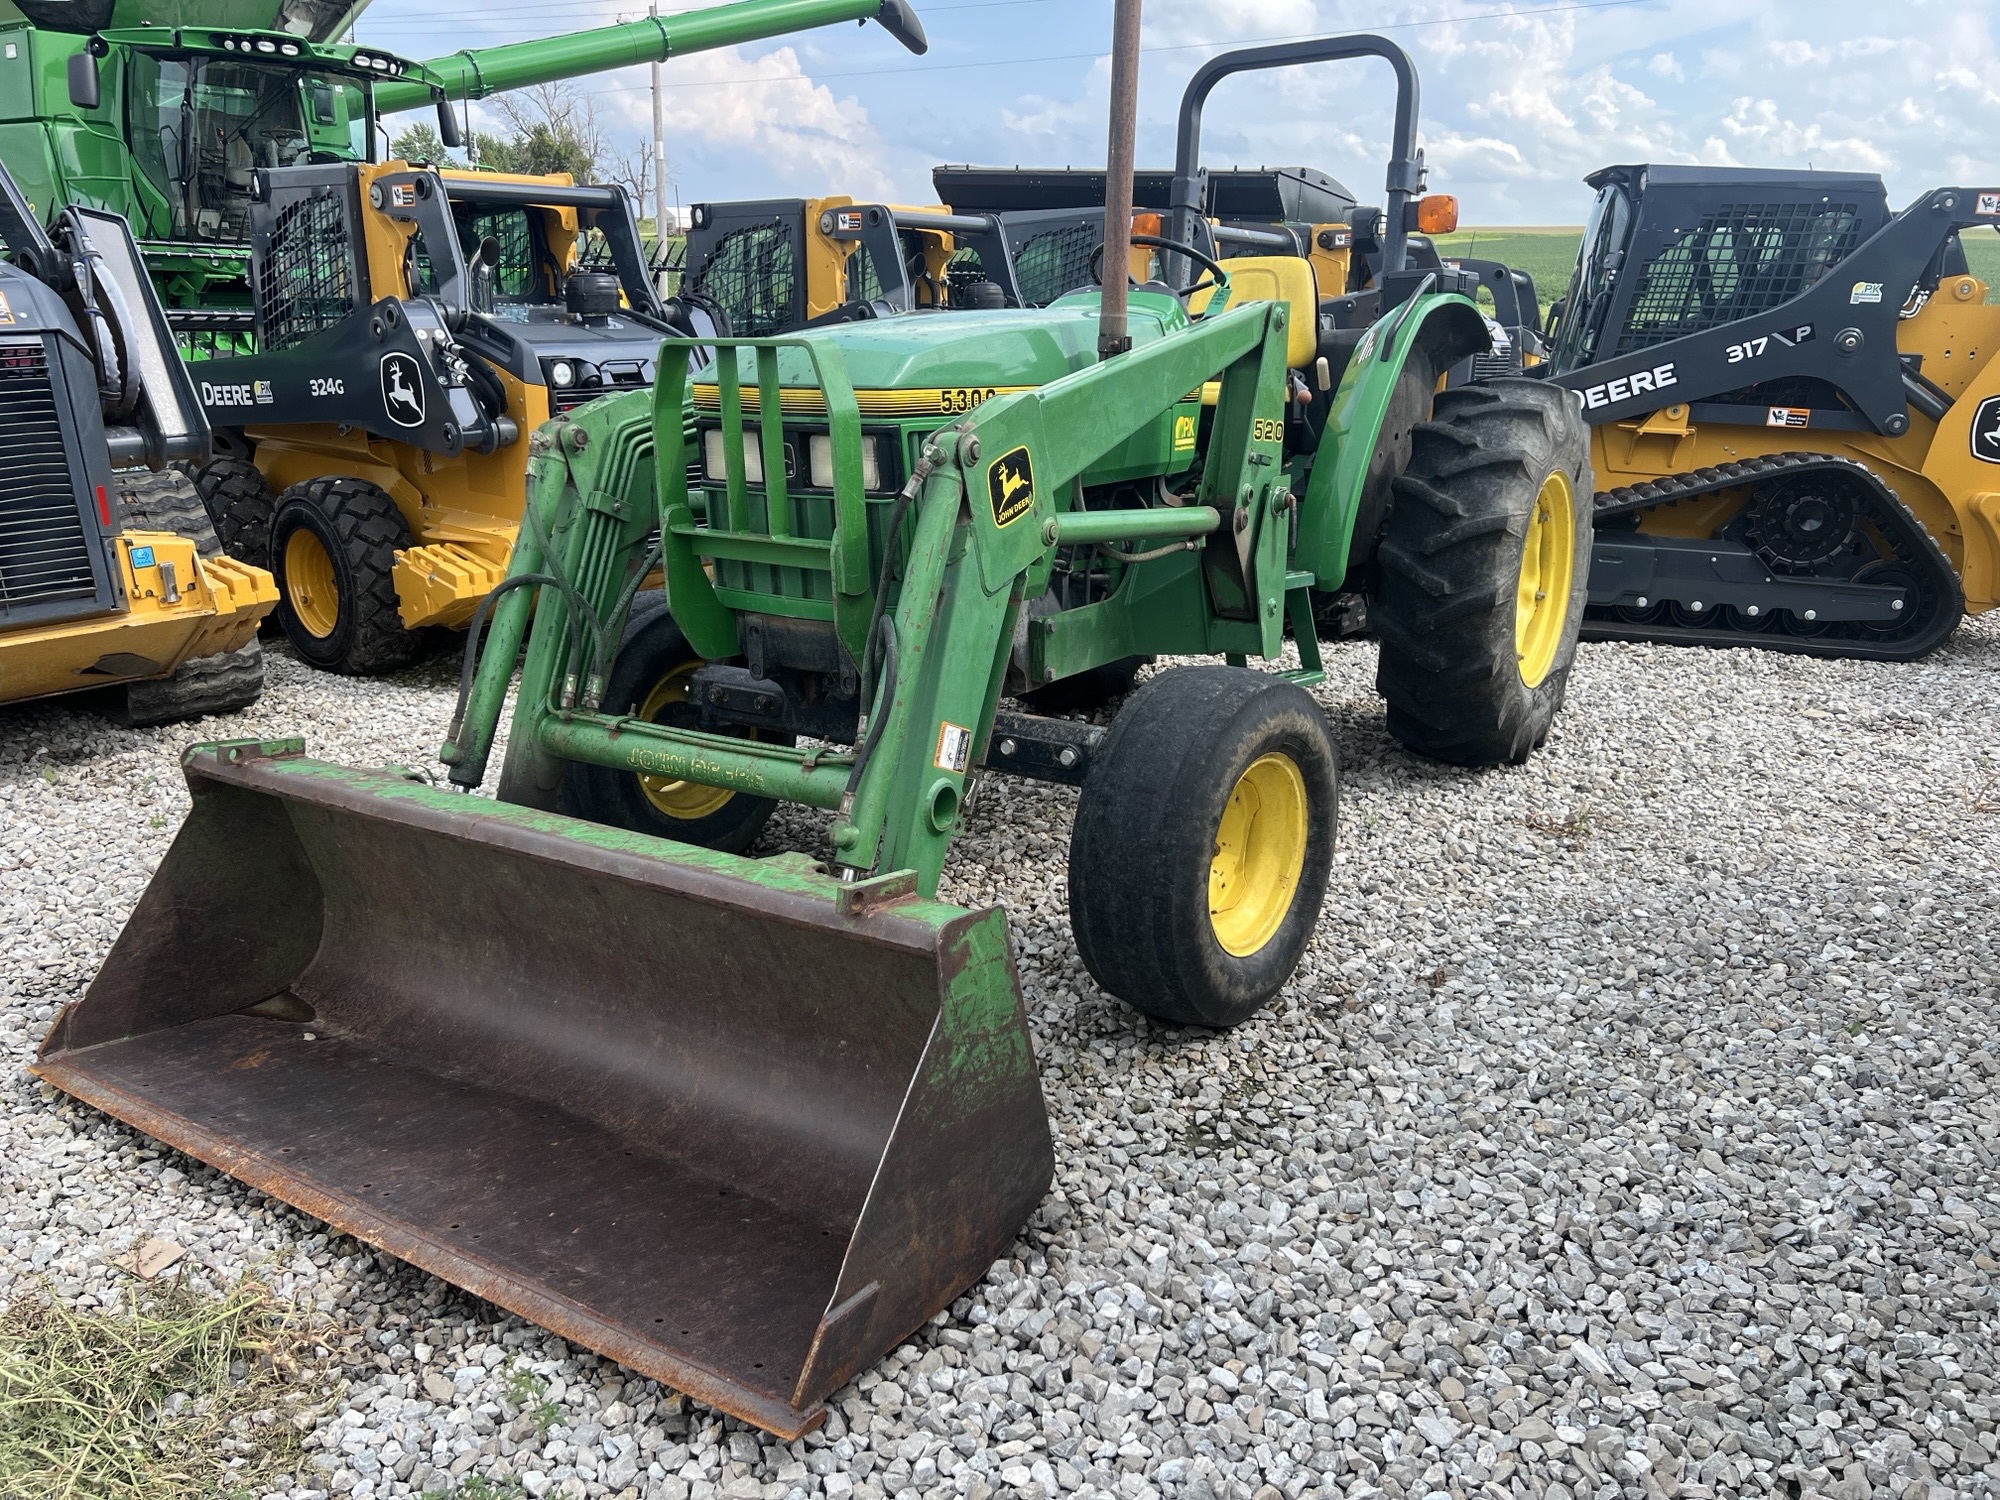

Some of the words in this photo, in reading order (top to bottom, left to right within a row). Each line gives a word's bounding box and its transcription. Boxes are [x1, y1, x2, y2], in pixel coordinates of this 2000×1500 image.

[1725, 336, 1769, 363] 317
[201, 381, 254, 406] DEERE
[309, 377, 345, 397] 324G
[1253, 418, 1284, 442] 520
[998, 506, 1014, 524] JOHN
[1013, 496, 1031, 513] DEER
